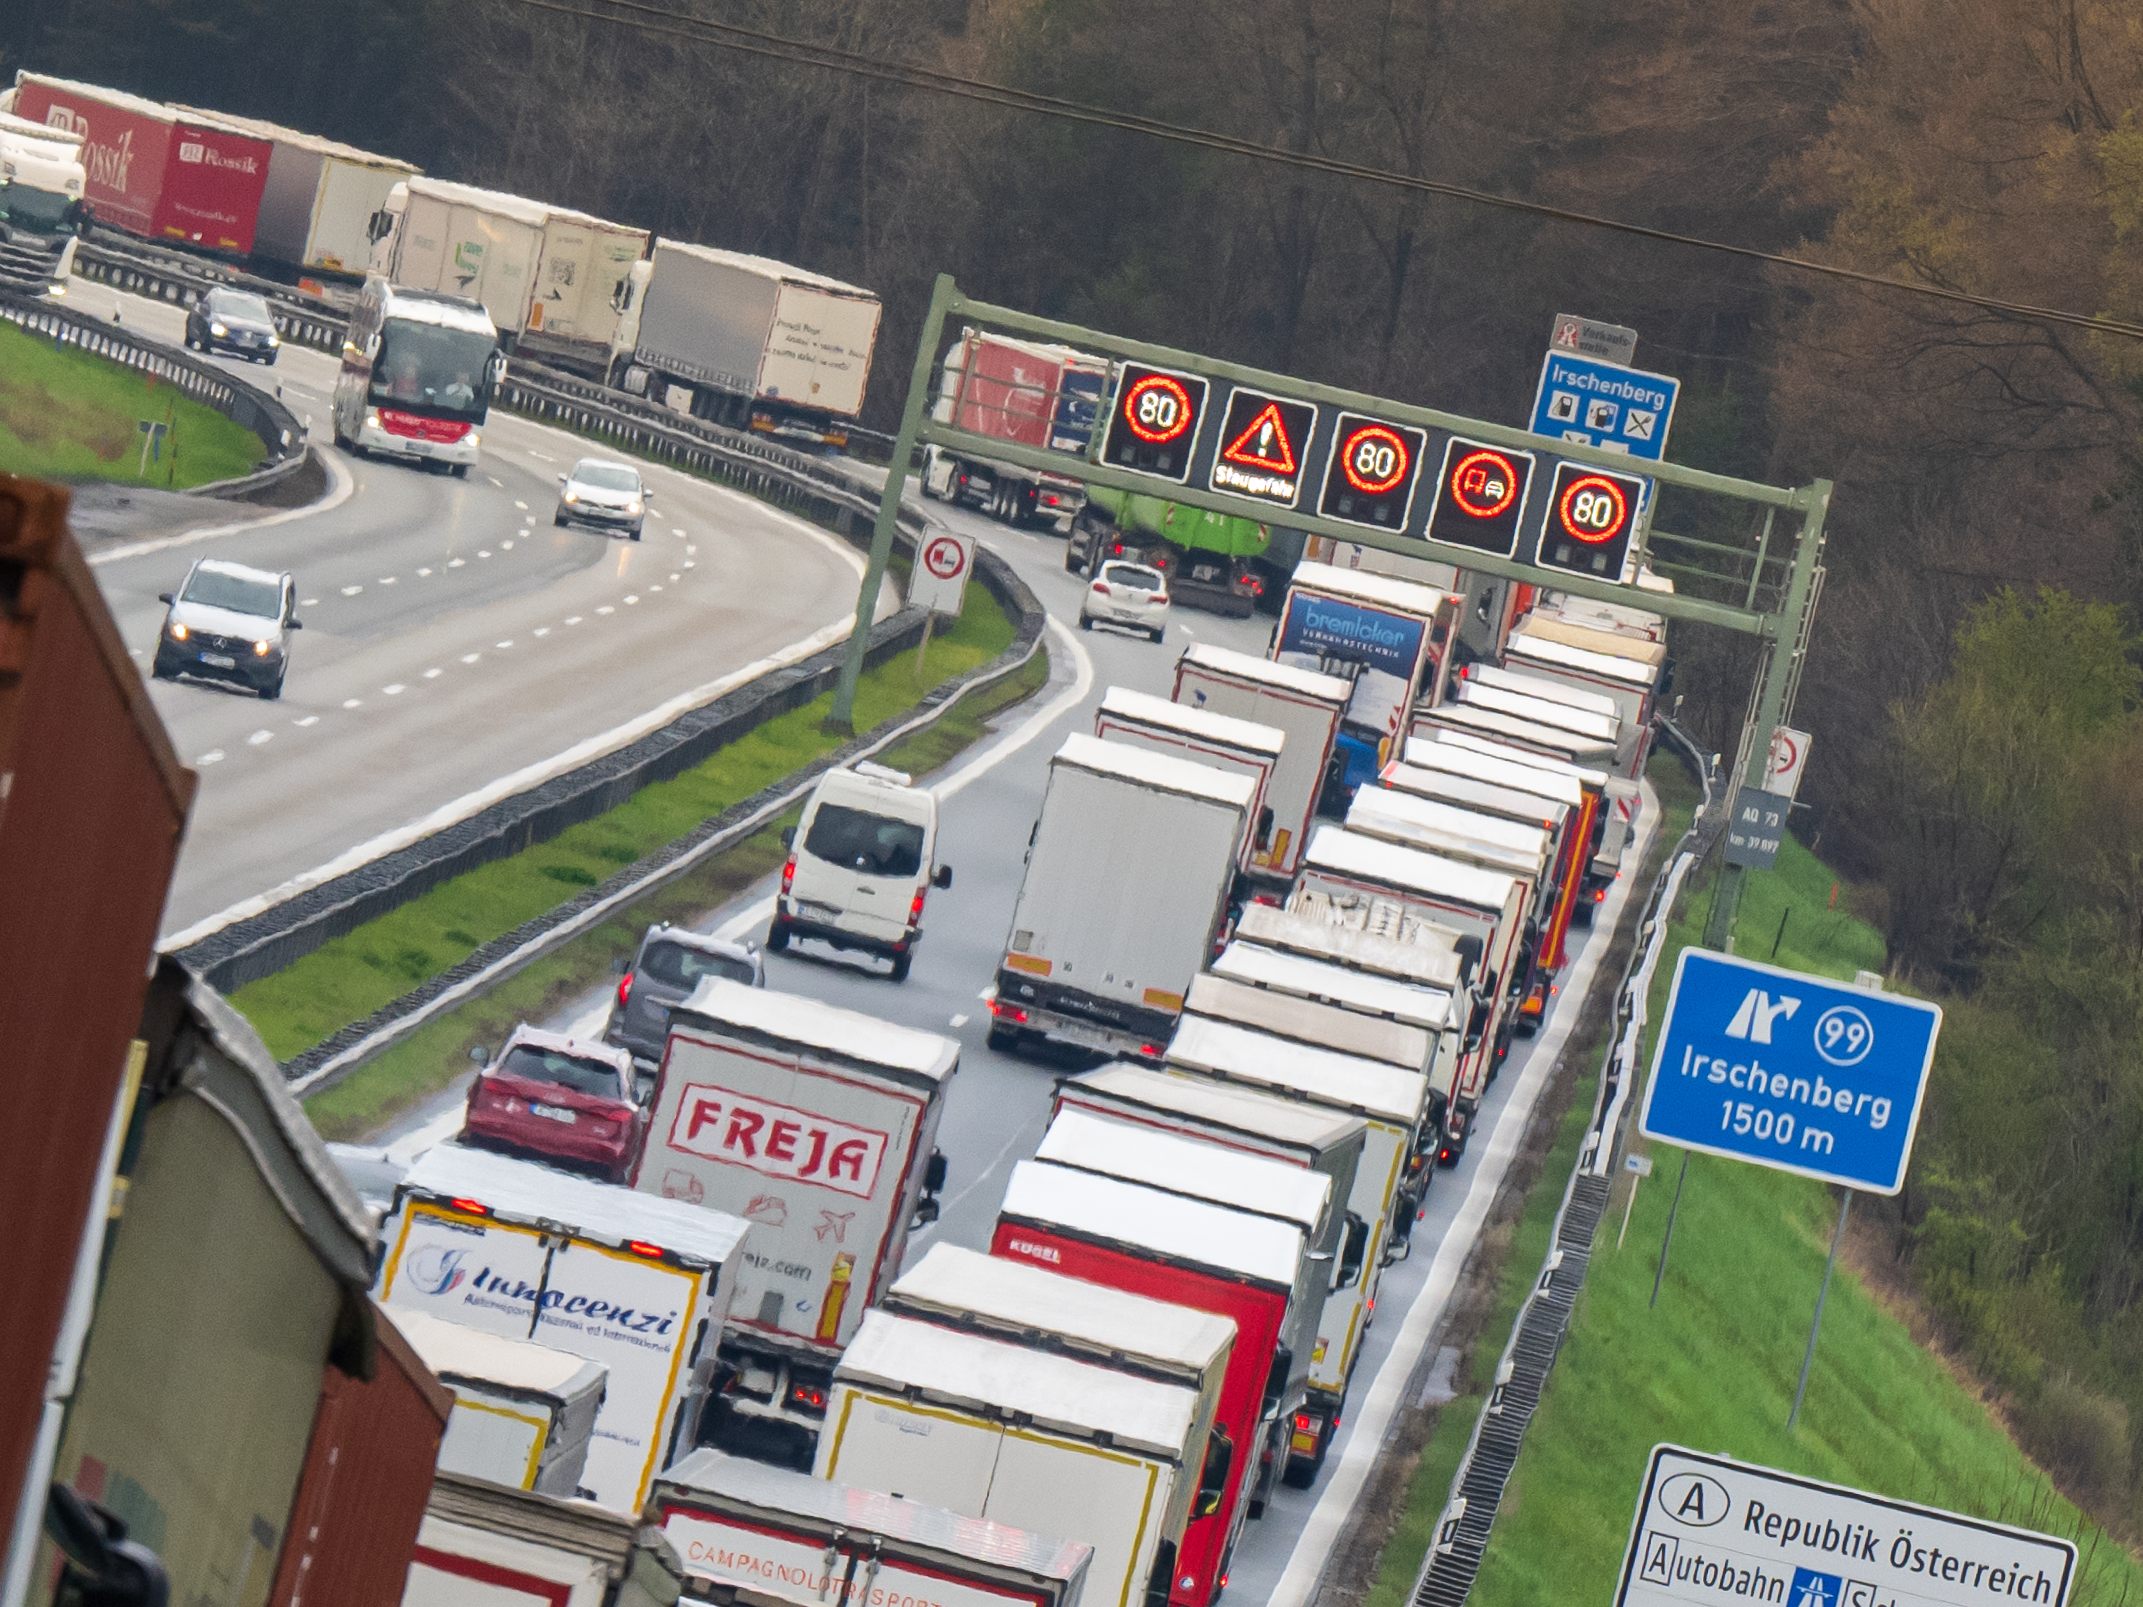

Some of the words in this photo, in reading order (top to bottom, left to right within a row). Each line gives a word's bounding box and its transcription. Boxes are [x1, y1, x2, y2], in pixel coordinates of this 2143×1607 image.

[205, 147, 258, 175] Rossik
[1552, 363, 1666, 411] Irschenberg
[1138, 391, 1178, 428] 80
[1356, 441, 1396, 478] 80
[1573, 490, 1612, 528] 80
[1730, 832, 1745, 846] km
[1824, 1017, 1865, 1053] 99
[1681, 1044, 1893, 1130] Irschenberg
[687, 1098, 869, 1182] FREJA
[1721, 1100, 1795, 1145] 1500
[1800, 1126, 1834, 1155] m
[1677, 1482, 1705, 1520] A
[1744, 1500, 1881, 1563] Republik
[1889, 1528, 2053, 1603] Österreich
[1648, 1542, 1786, 1604] Autobahn
